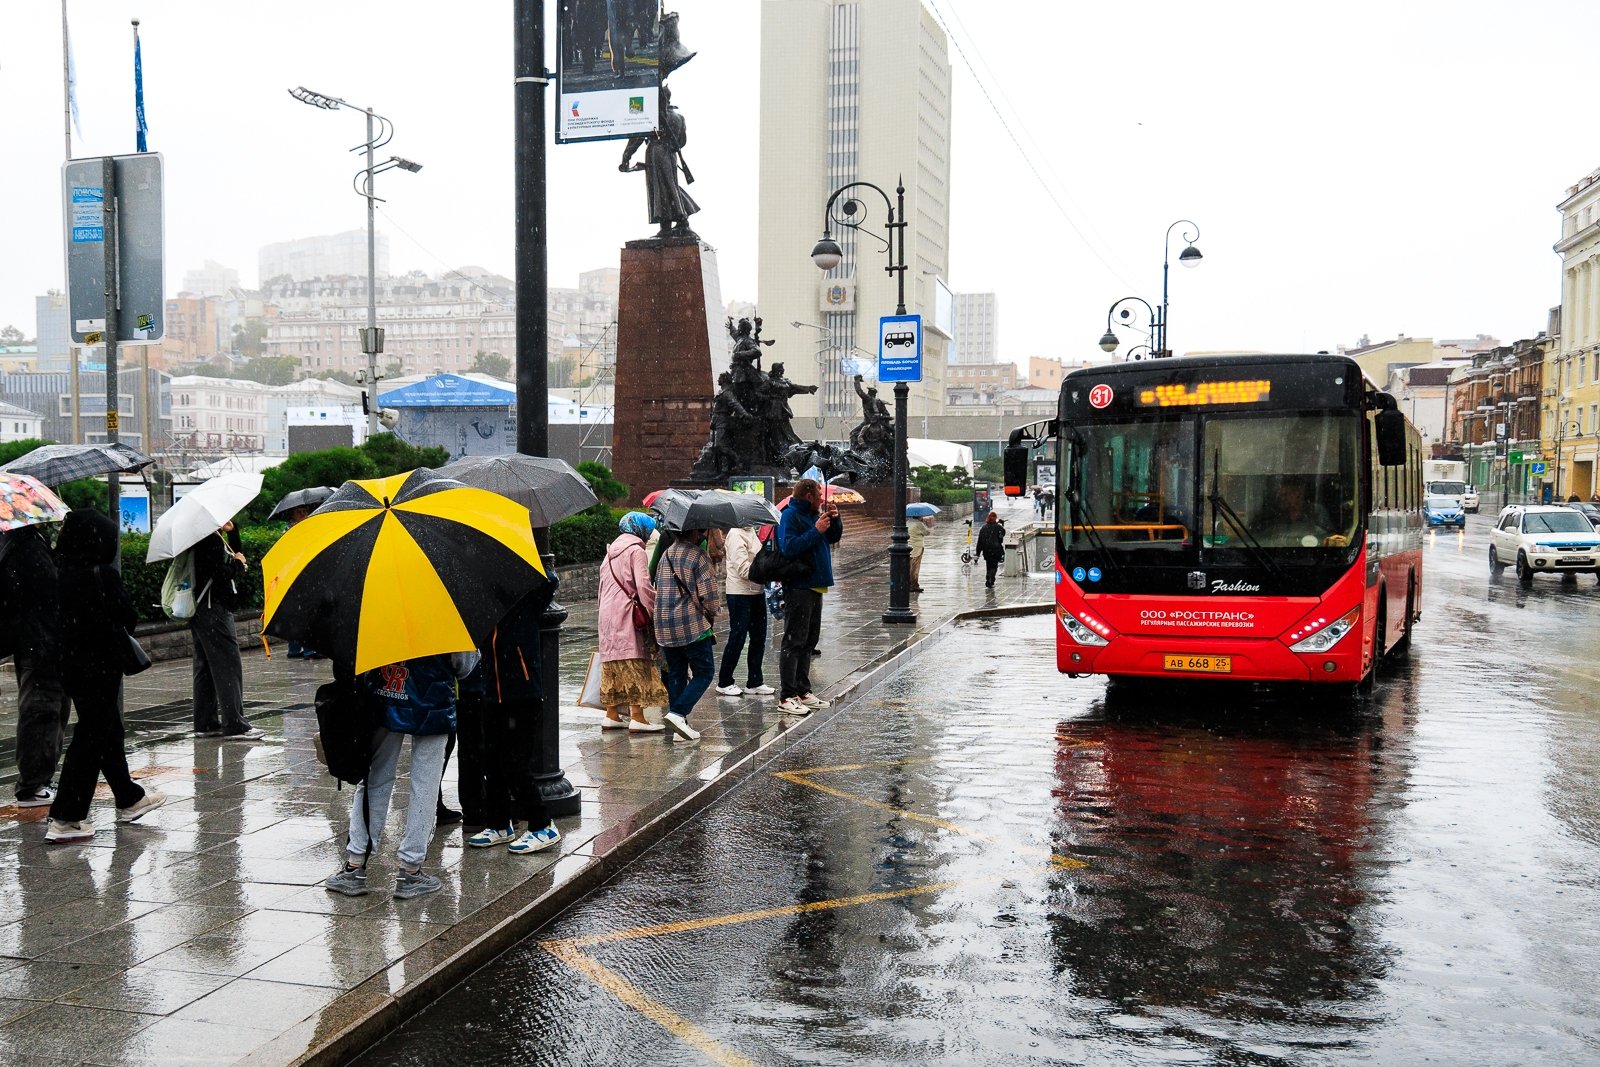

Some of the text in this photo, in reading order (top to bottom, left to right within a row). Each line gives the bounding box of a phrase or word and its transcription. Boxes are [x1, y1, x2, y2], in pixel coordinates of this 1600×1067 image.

[1092, 388, 1109, 405] 31
[1211, 579, 1260, 593] Fashion
[1140, 610, 1255, 620] ООО «РОСТТРАНС»
[1188, 658, 1209, 668] 668
[1215, 658, 1227, 666] 25
